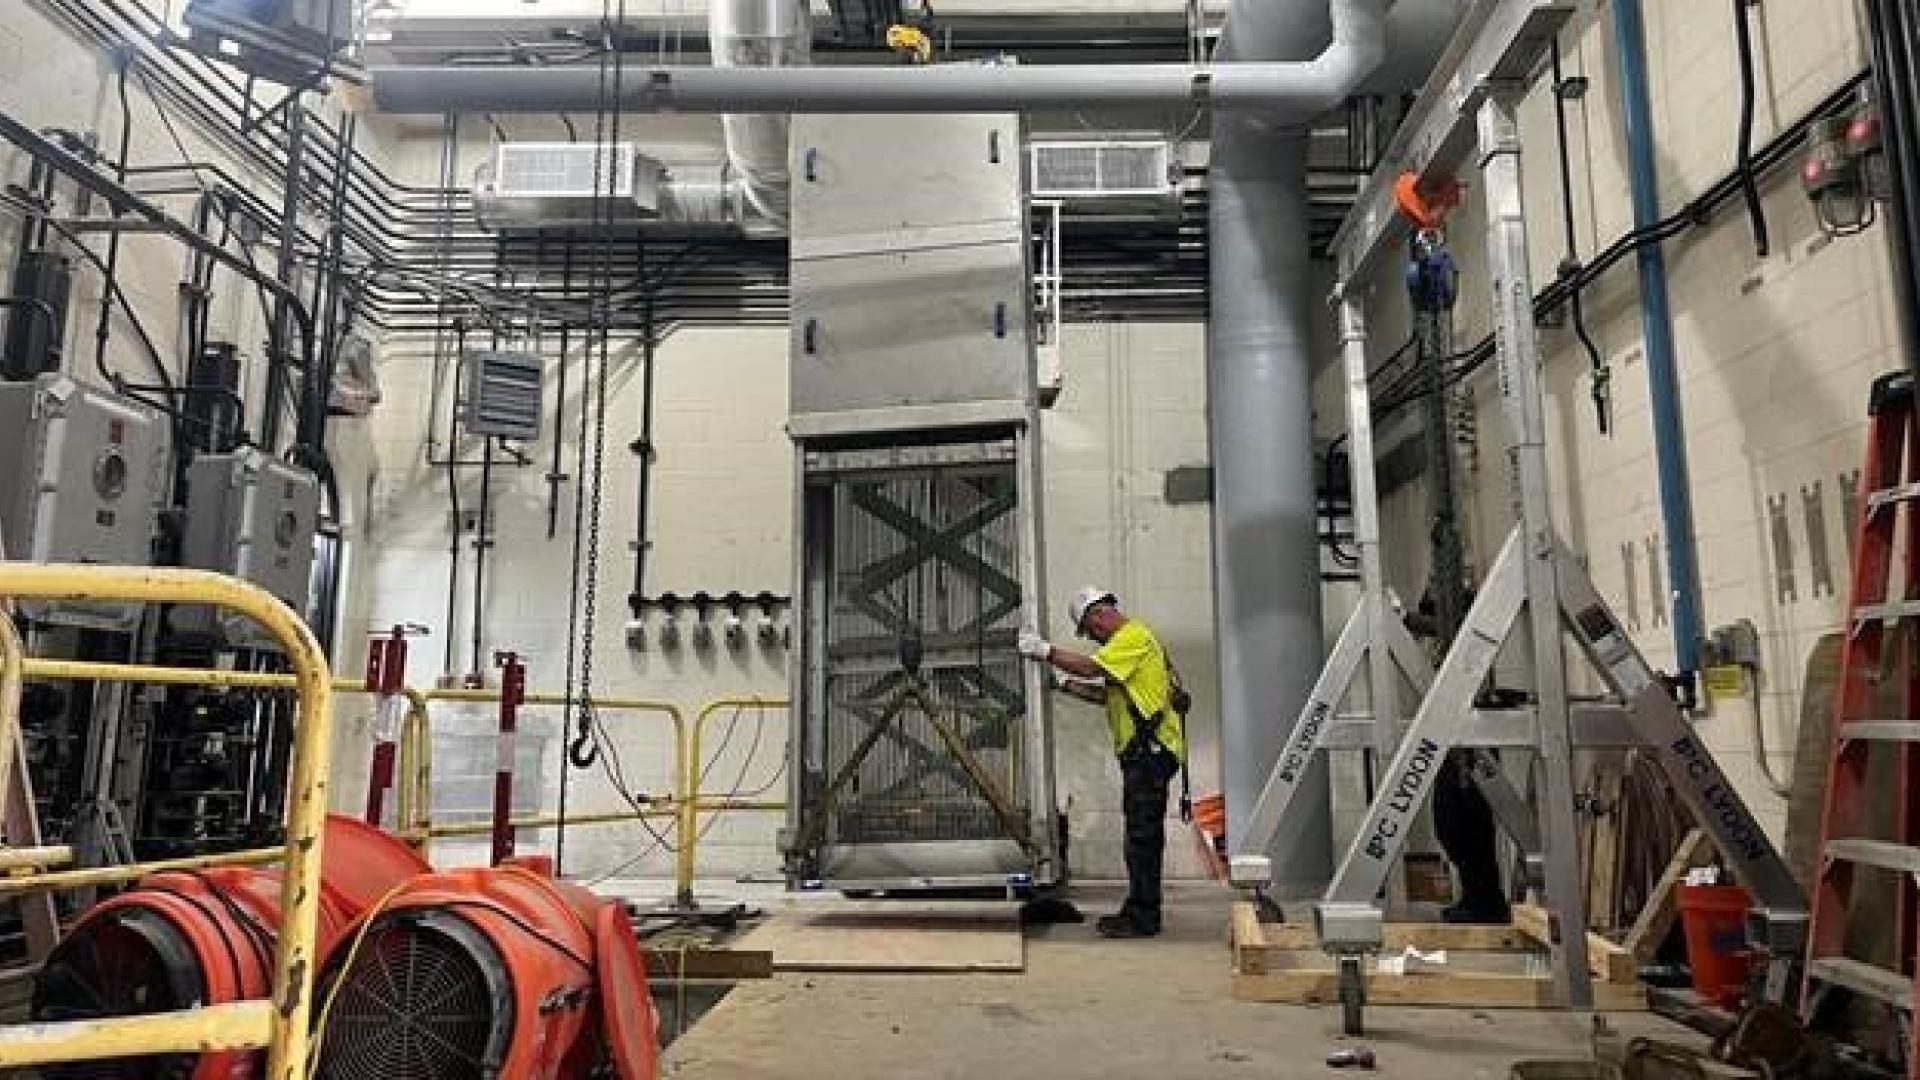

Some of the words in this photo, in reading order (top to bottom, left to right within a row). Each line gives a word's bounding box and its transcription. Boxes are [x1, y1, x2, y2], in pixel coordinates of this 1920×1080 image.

[1296, 701, 1329, 751] LYDON
[1388, 738, 1438, 813] LYDON
[1704, 784, 1765, 861] LYDON
